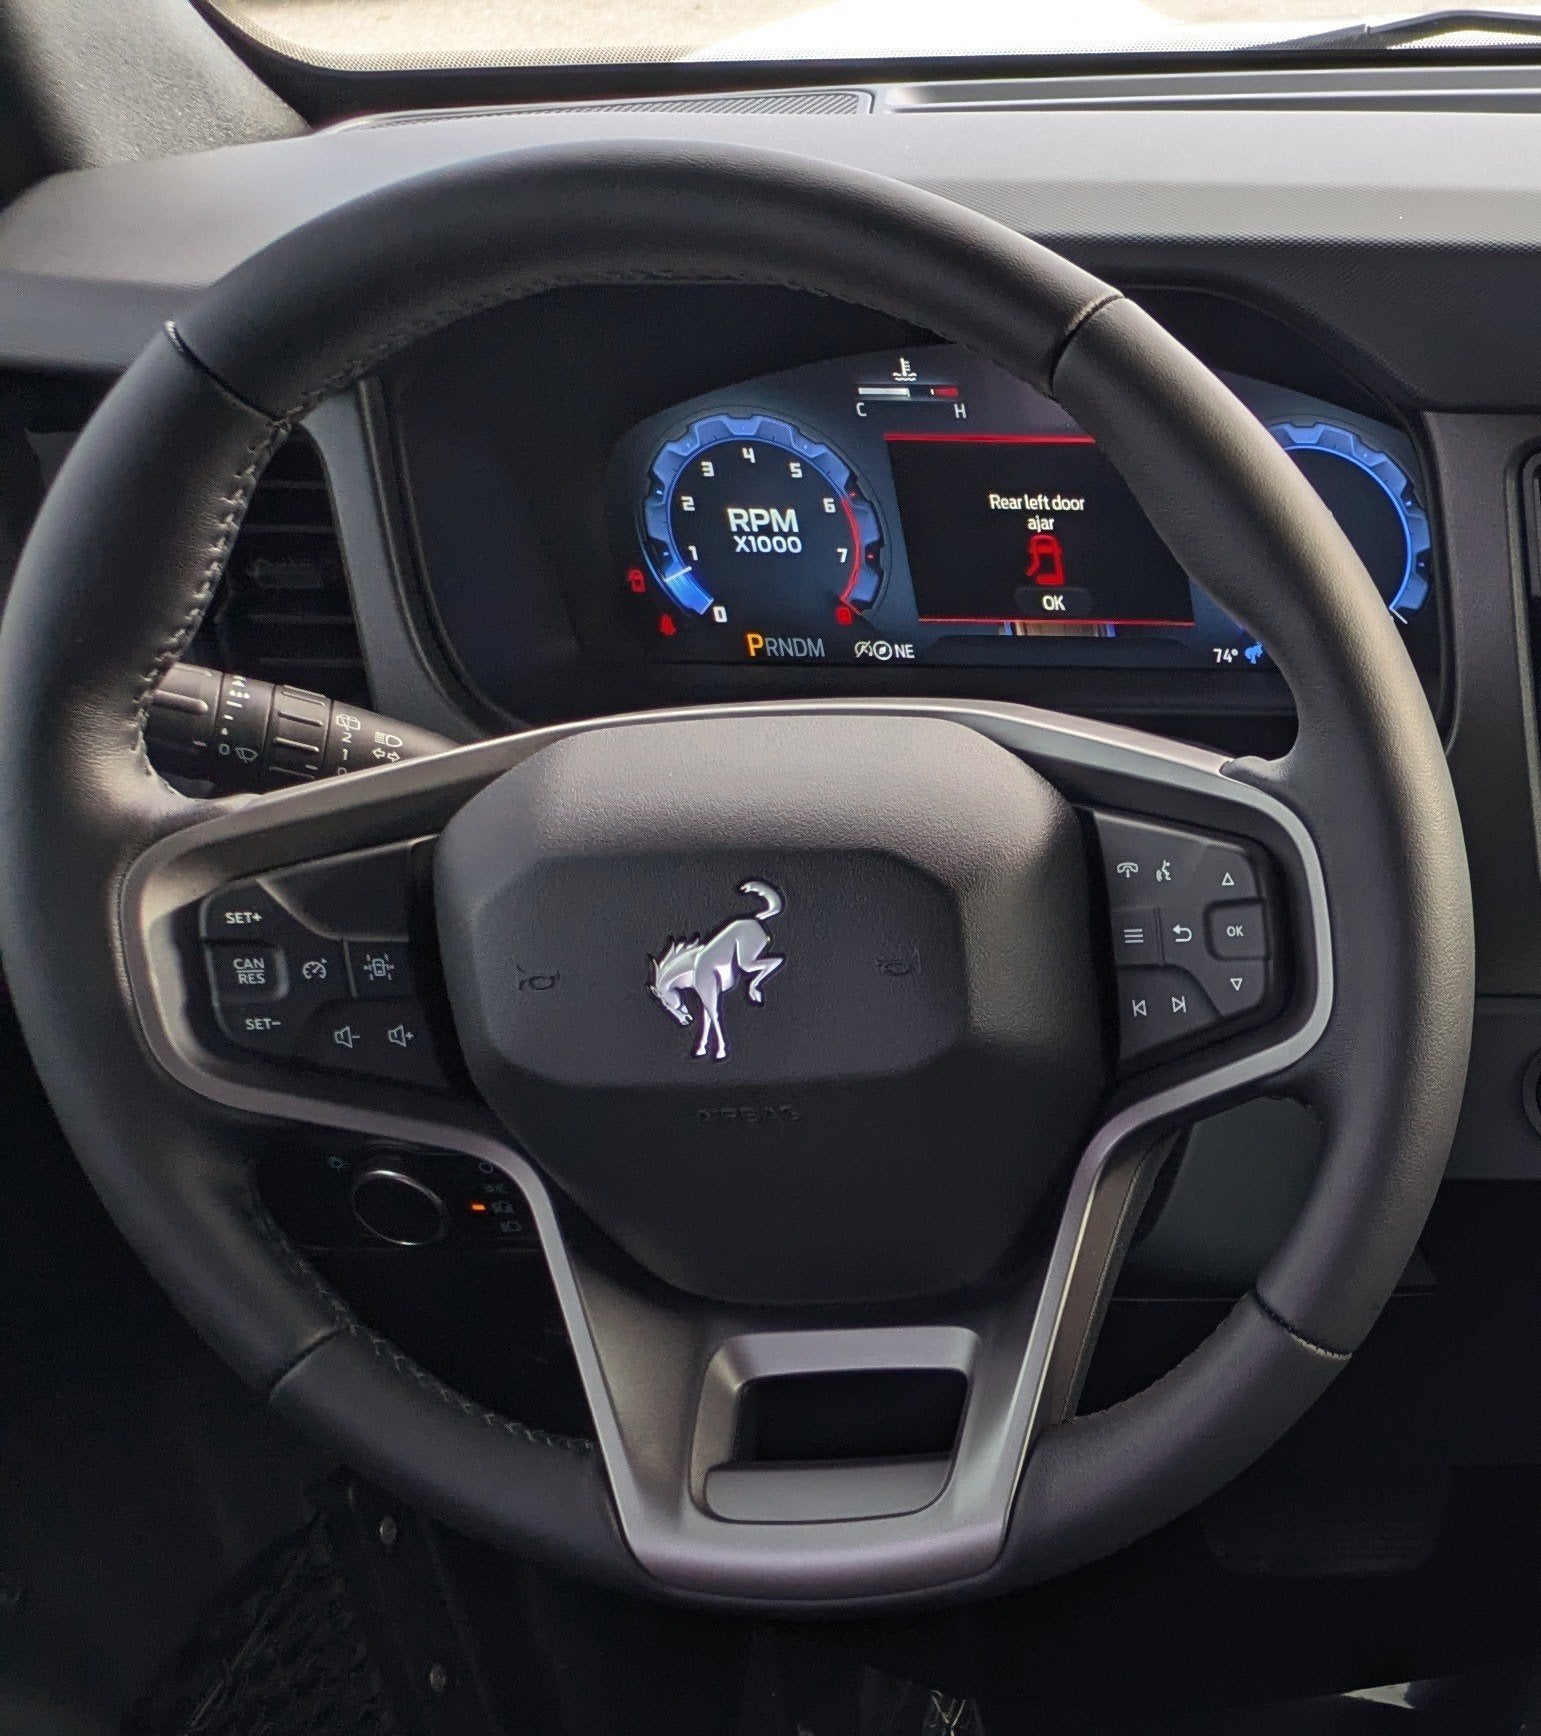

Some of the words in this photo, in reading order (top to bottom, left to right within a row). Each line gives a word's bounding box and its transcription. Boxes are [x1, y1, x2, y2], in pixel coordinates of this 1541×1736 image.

[855, 402, 868, 417] C
[954, 403, 967, 419] H
[741, 447, 756, 463] 4
[700, 461, 715, 477] 3
[789, 462, 802, 478] 5
[681, 496, 695, 511] 2
[823, 498, 836, 513] 6
[989, 494, 1022, 510] Rear
[1024, 494, 1051, 510] left
[1052, 495, 1085, 511] door
[726, 508, 800, 533] RPM
[1027, 514, 1054, 533] ajar
[734, 535, 803, 553] X1000
[688, 545, 698, 561] 1
[836, 547, 848, 563] 7
[1042, 595, 1066, 611] OK
[713, 605, 728, 623] 0
[894, 644, 915, 659] NE
[1213, 648, 1238, 663] 74°
[225, 911, 262, 925] SET+
[1226, 924, 1244, 938] OK
[233, 957, 265, 971] CAN
[238, 972, 266, 986] RES
